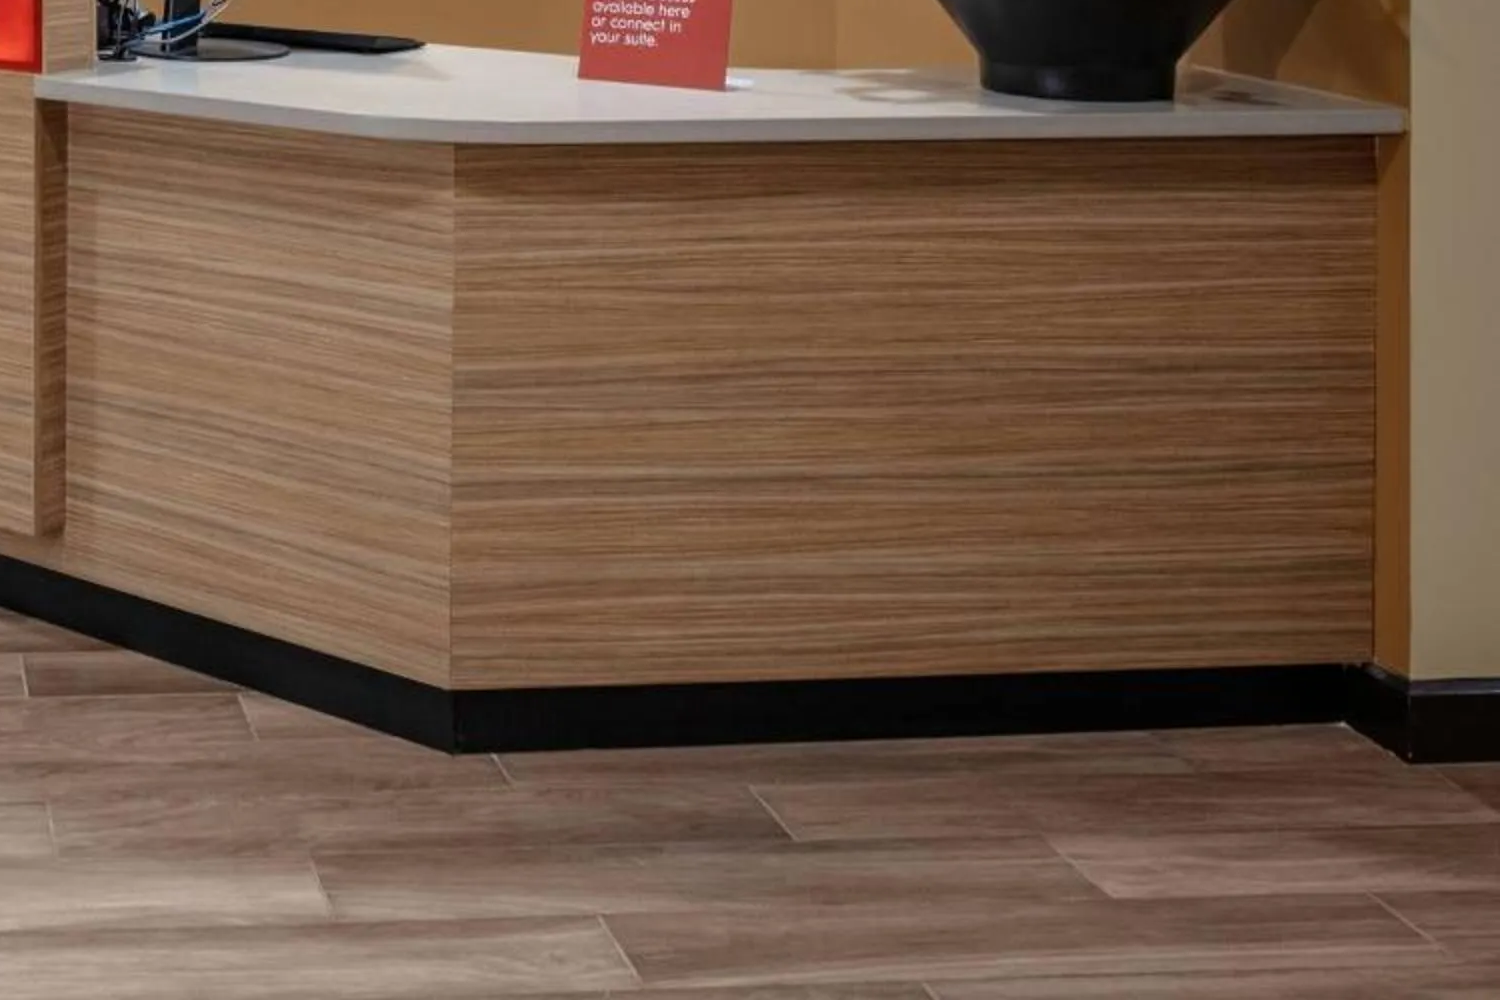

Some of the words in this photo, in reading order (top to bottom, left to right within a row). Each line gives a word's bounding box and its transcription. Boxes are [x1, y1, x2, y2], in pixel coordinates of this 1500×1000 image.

[592, 0, 655, 16] available
[658, 4, 691, 18] here
[591, 16, 606, 27] or
[610, 16, 665, 30] connect
[669, 20, 682, 32] in
[590, 31, 620, 45] your
[623, 32, 658, 47] suite.
